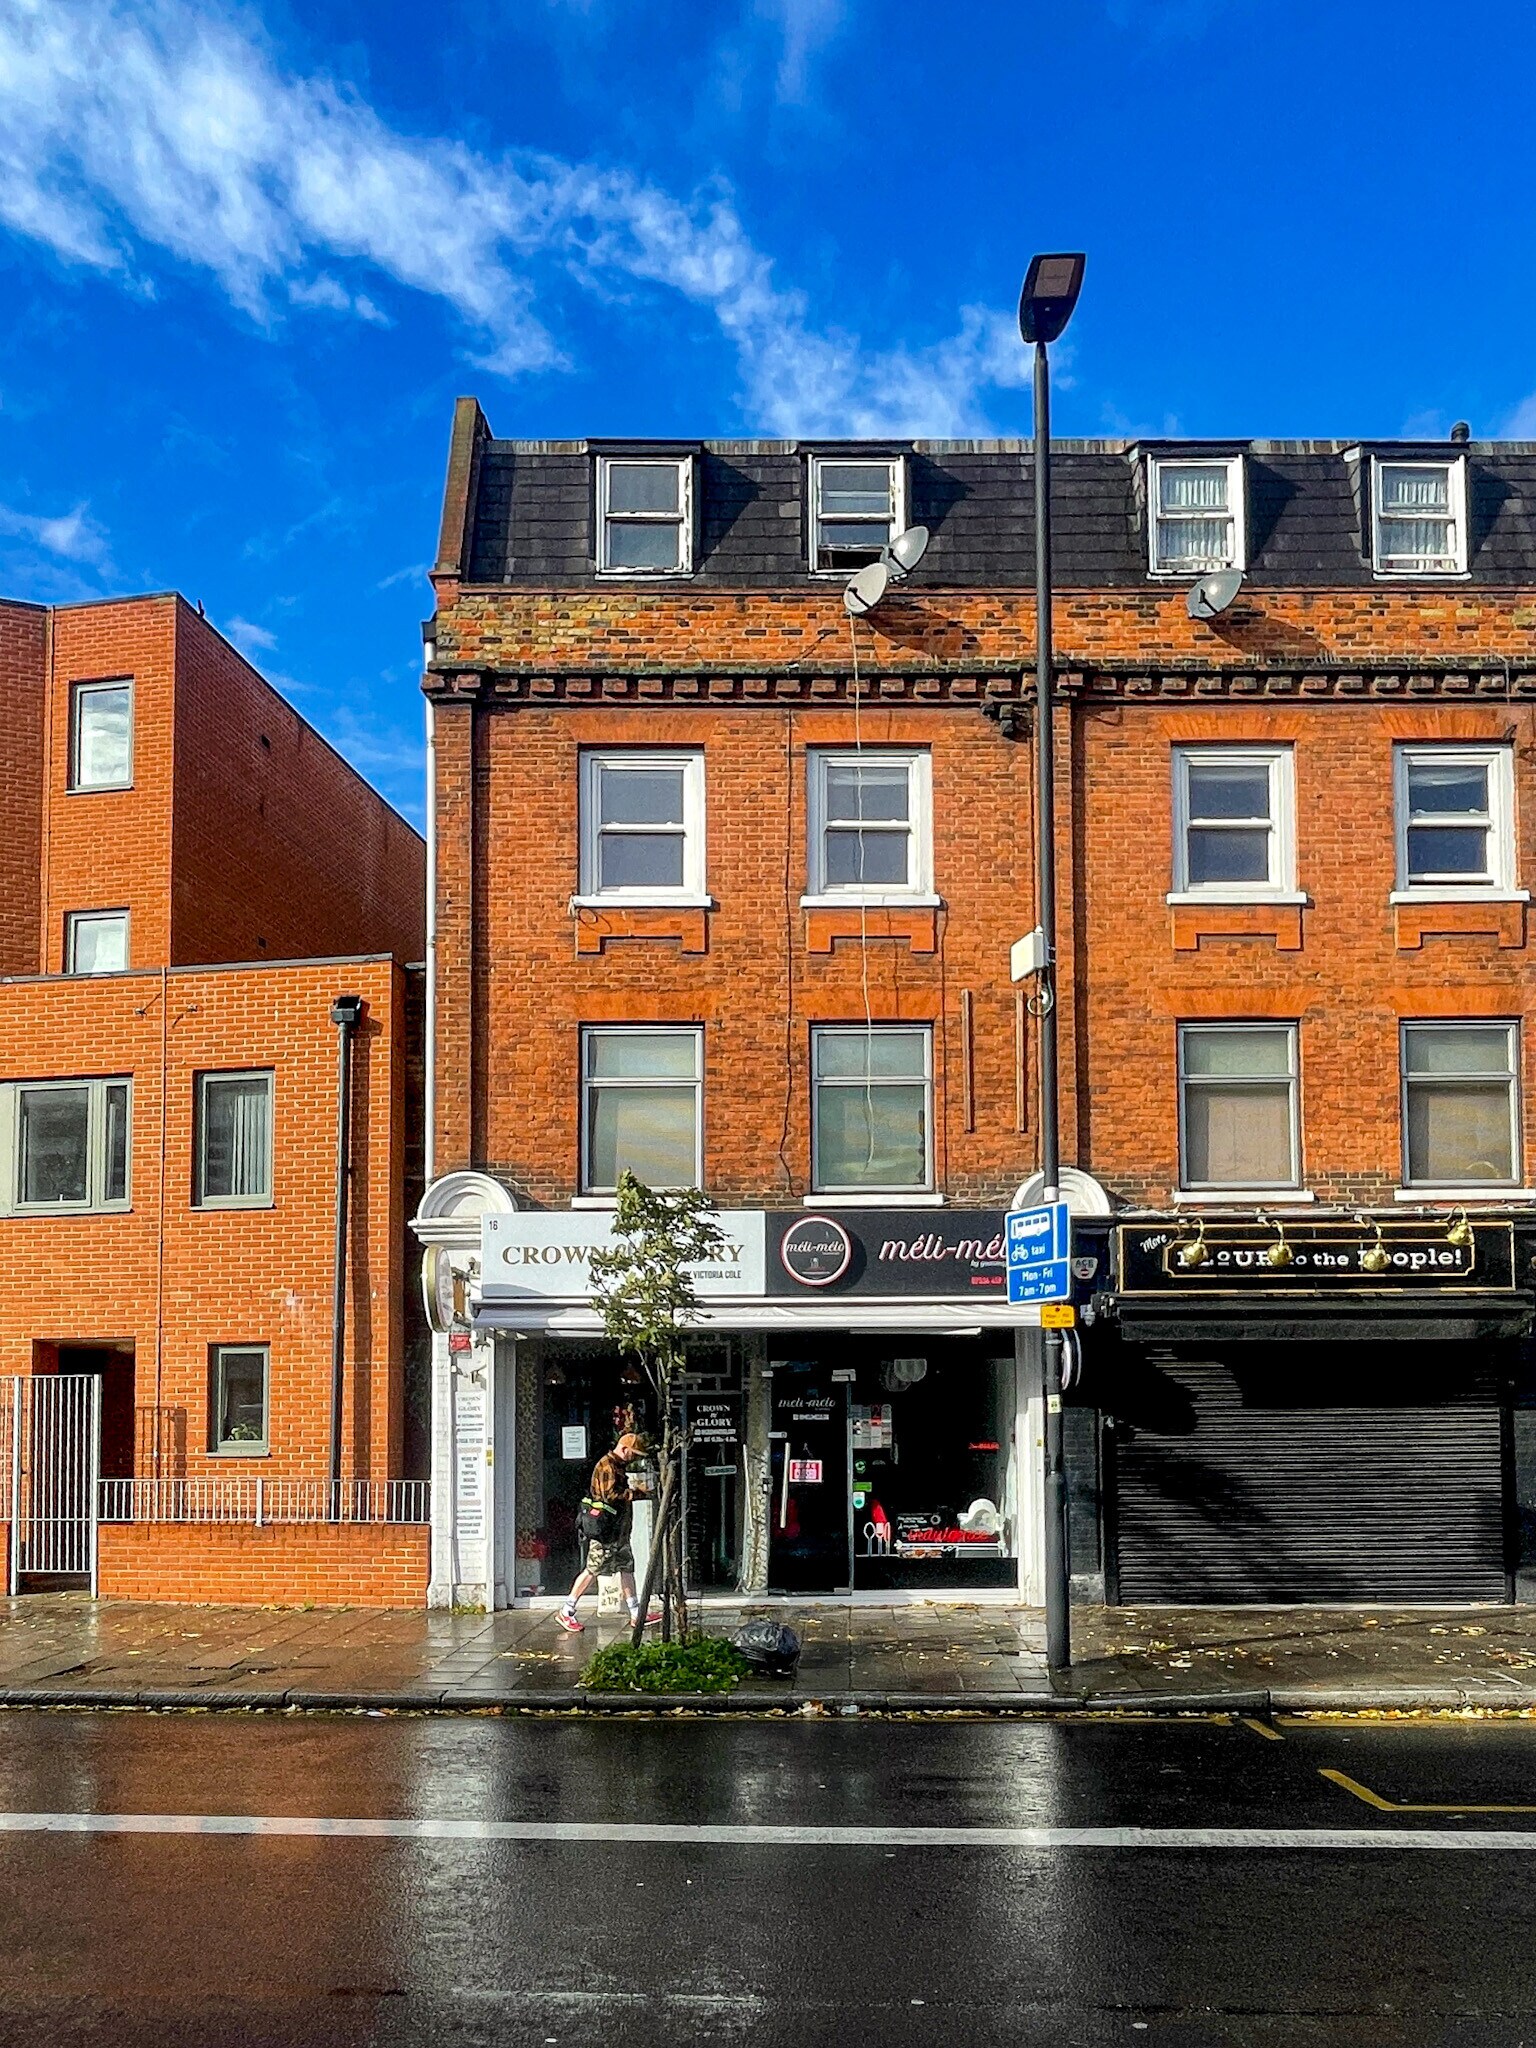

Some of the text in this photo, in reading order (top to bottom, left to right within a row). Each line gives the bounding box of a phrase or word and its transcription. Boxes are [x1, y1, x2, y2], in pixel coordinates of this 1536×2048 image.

[489, 1220, 499, 1231] 16
[786, 1241, 845, 1253] méli-mélo
[878, 1233, 1007, 1261] méli-mél
[1031, 1243, 1046, 1256] taxi
[1140, 1234, 1167, 1253] More
[1313, 1252, 1349, 1266] the
[1357, 1248, 1462, 1270] ople!
[693, 1270, 723, 1279] VICTORIA
[725, 1270, 742, 1279] COLE
[696, 1404, 731, 1413] CROWN
[696, 1418, 733, 1427] GLORY
